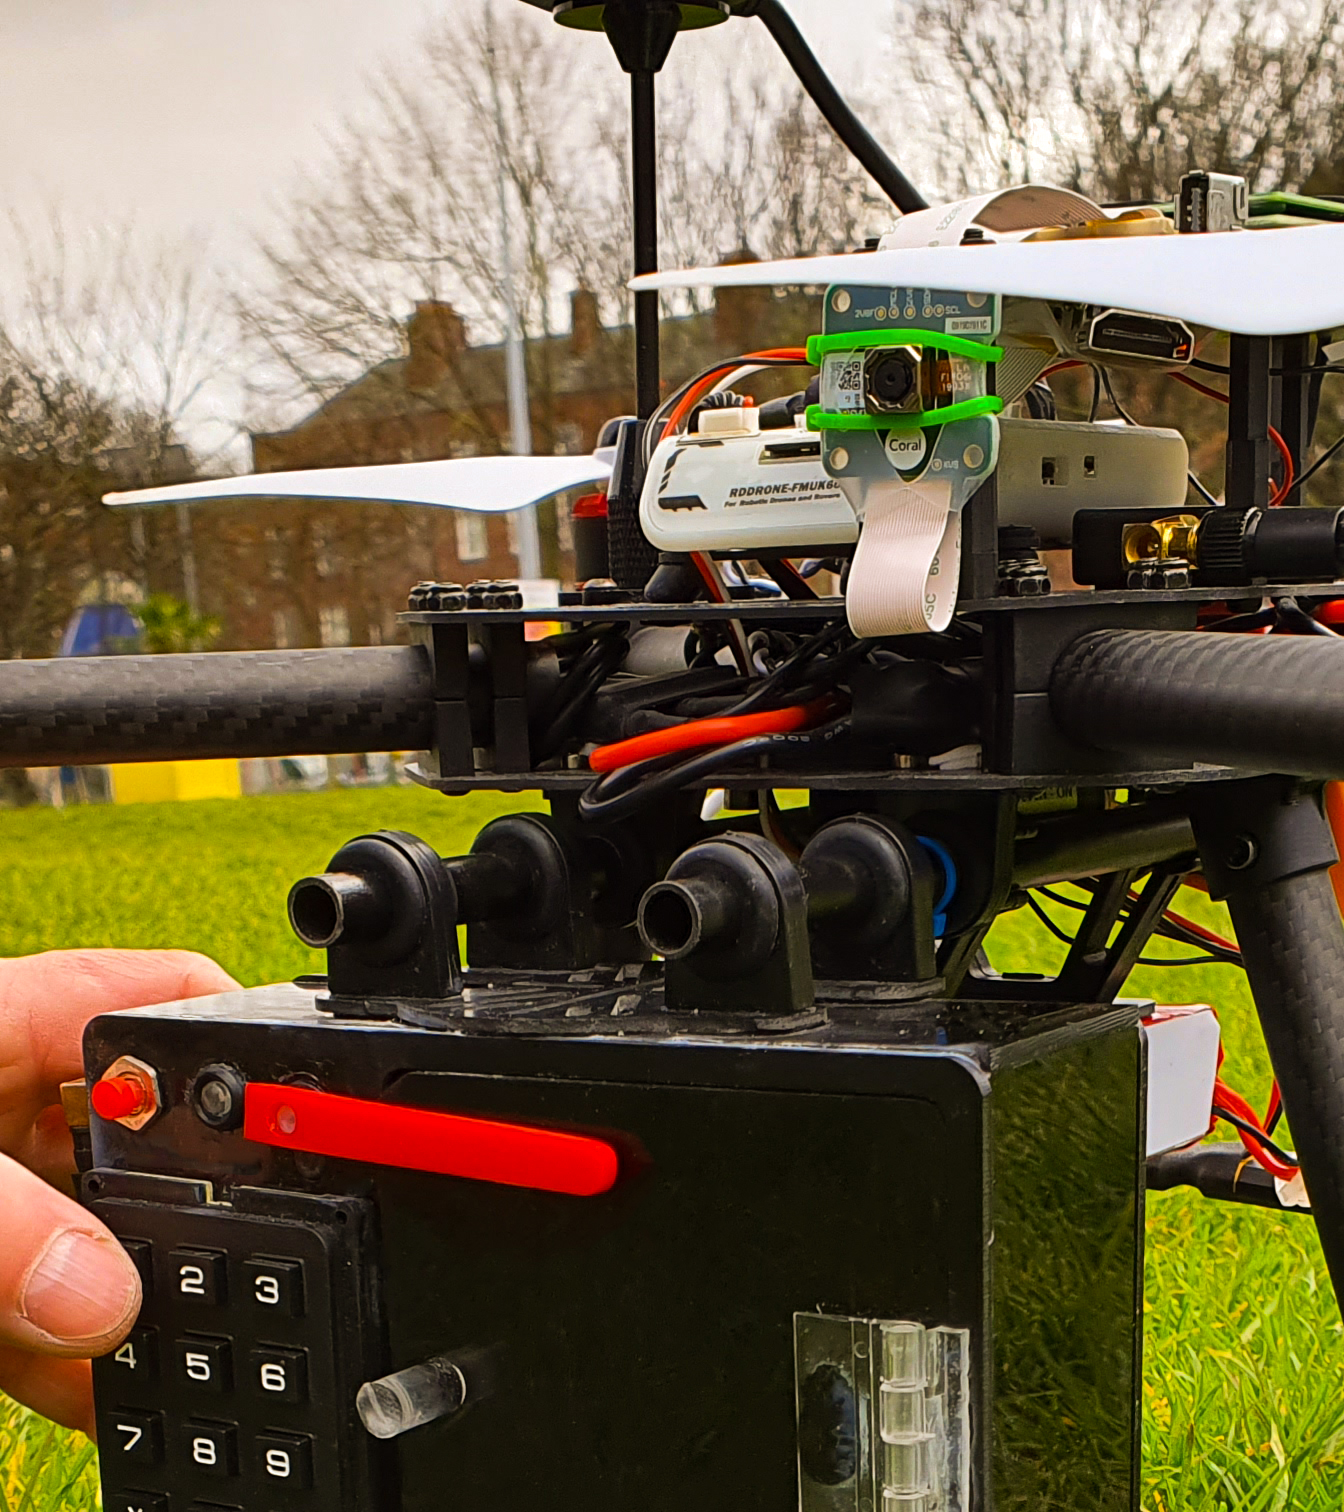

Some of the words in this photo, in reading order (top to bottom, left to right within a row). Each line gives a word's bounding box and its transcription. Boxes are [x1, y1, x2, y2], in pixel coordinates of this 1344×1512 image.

[945, 305, 961, 315] SCL
[889, 438, 922, 452] Coral
[179, 1265, 205, 1295] 2
[255, 1275, 279, 1304] 3
[114, 1342, 137, 1369] 4
[185, 1352, 211, 1381] 5
[260, 1363, 286, 1392] 6
[116, 1424, 143, 1451] 7
[192, 1437, 217, 1465] 8
[266, 1449, 291, 1478] 9
